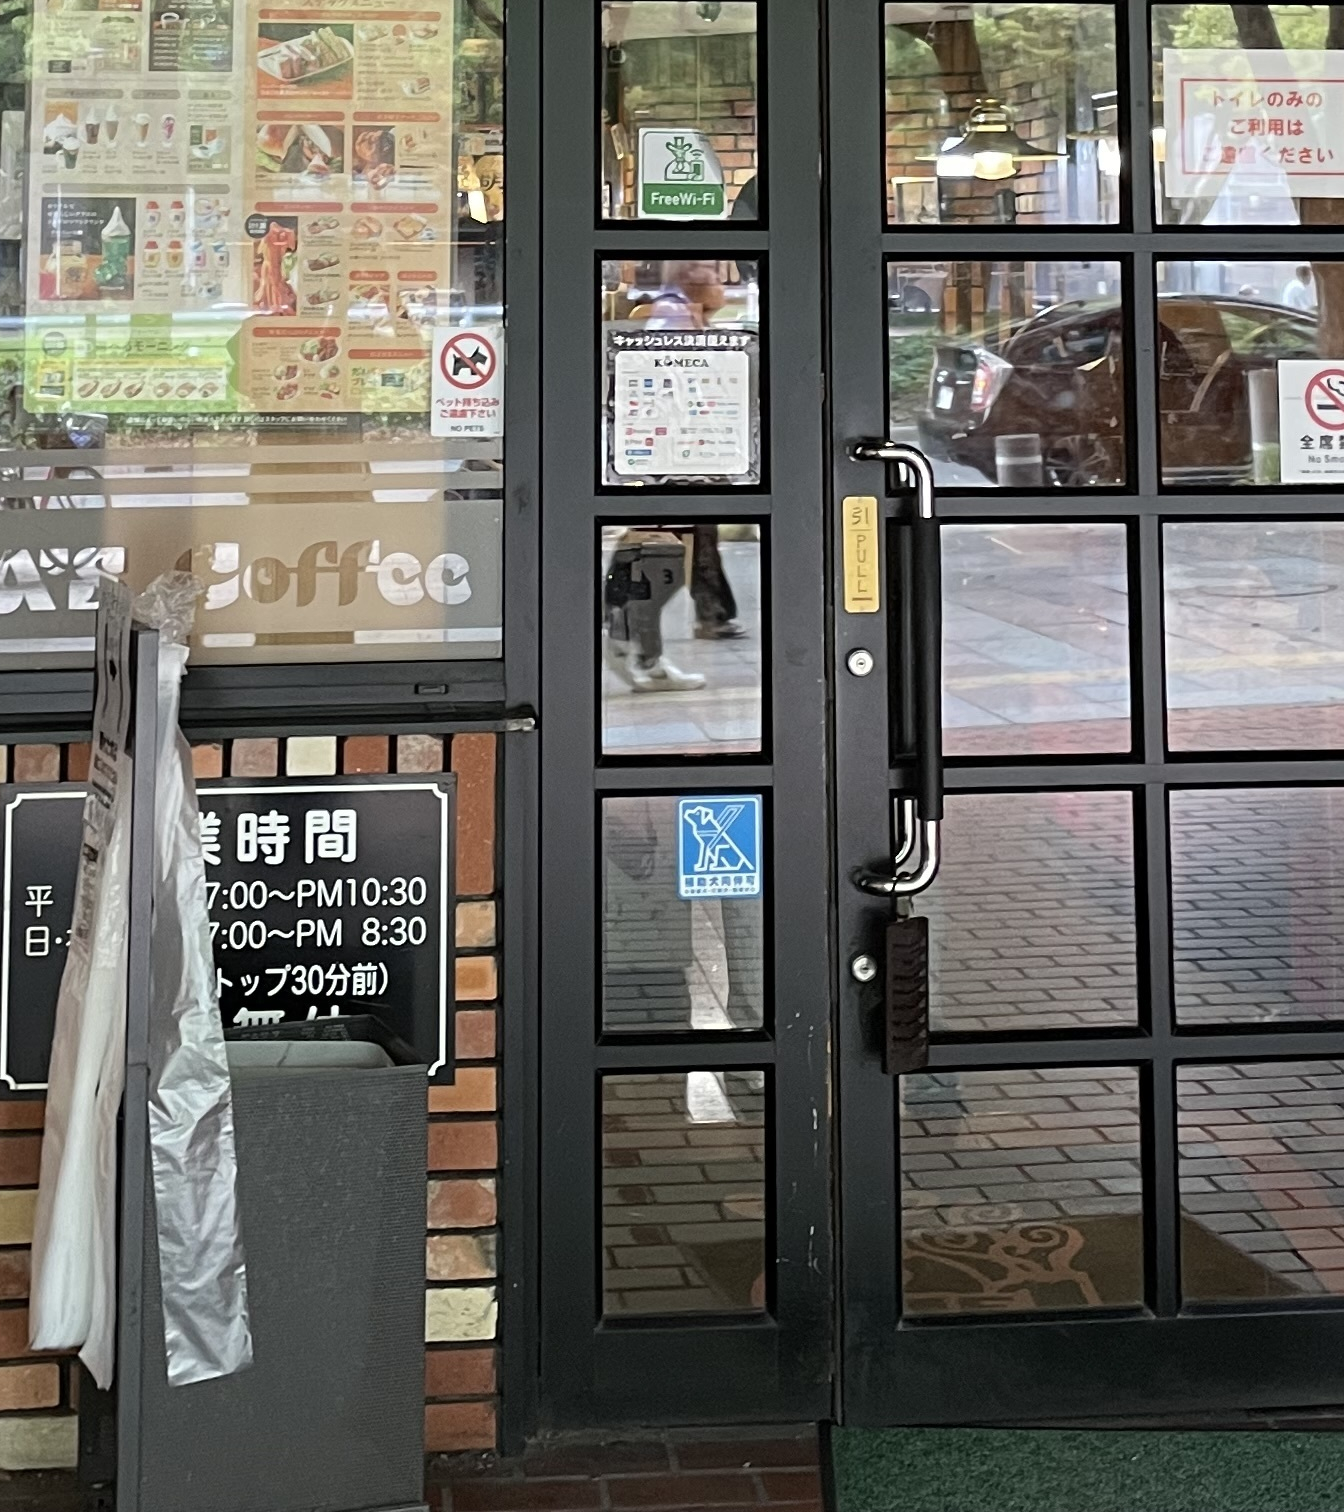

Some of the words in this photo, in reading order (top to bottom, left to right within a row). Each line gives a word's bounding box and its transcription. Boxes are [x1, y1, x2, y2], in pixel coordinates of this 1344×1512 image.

[1212, 90, 1323, 108] トイレのみの
[1230, 118, 1305, 136] ご利用は
[450, 424, 463, 432] NO
[463, 424, 485, 432] PETS
[1308, 454, 1322, 464] No
[855, 533, 868, 593] PULL
[361, 916, 427, 946] 8:30
